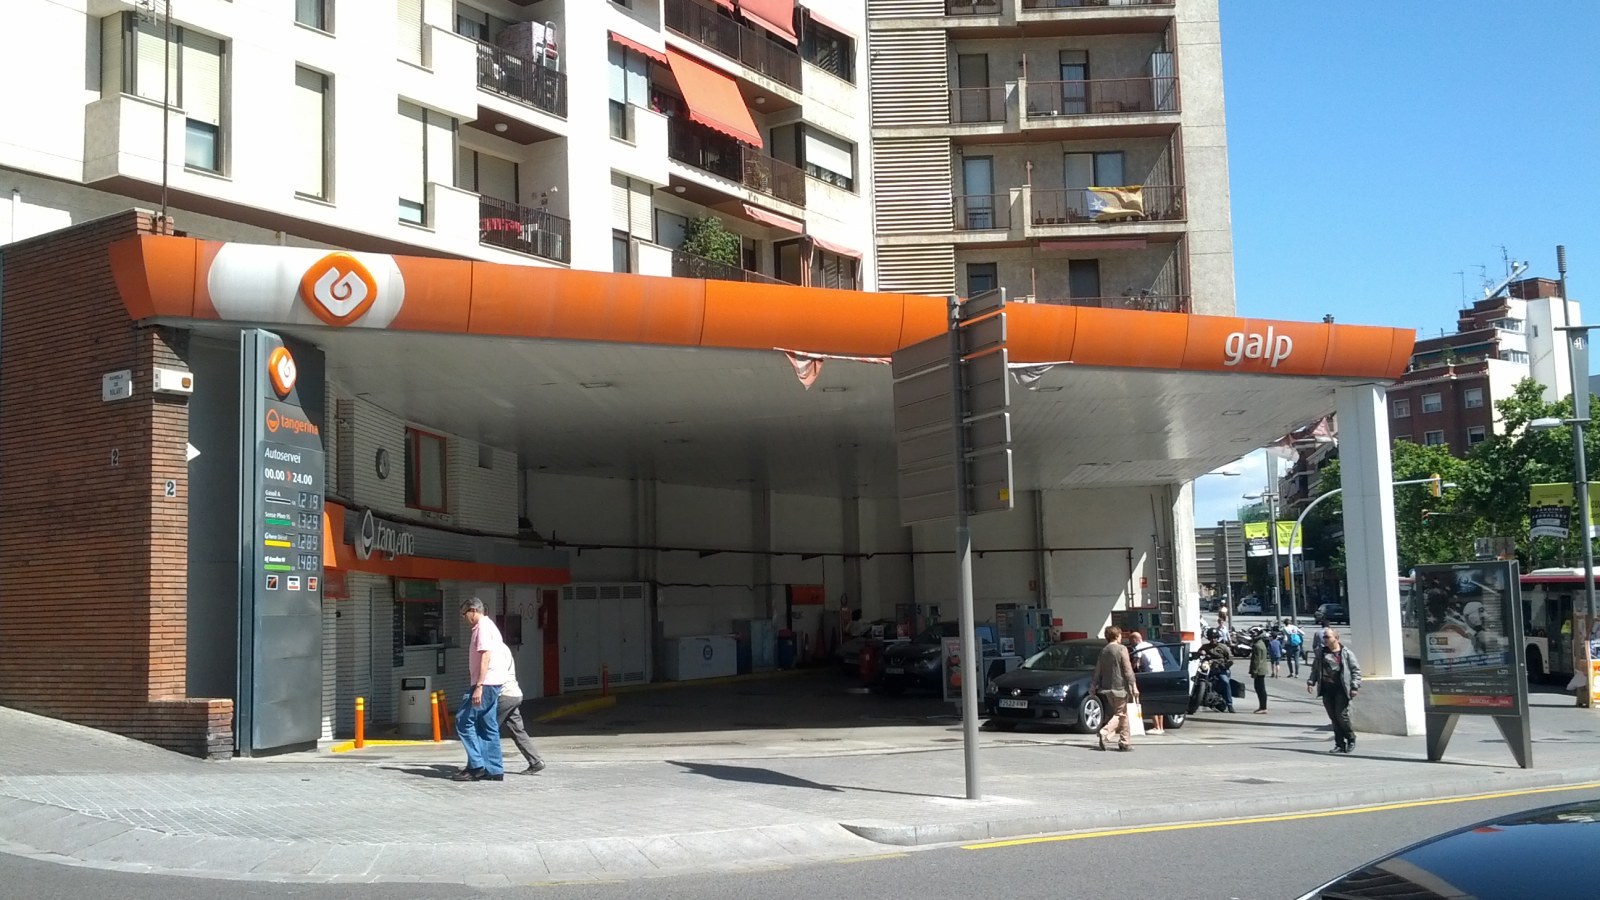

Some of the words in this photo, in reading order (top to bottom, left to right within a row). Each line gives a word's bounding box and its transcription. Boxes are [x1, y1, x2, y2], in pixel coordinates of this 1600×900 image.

[1223, 325, 1293, 368] galp
[281, 414, 319, 436] tangerina
[112, 450, 118, 464] 2
[264, 447, 301, 464] Autoservei
[264, 467, 285, 481] 00.00
[292, 472, 313, 486] 24.00
[166, 480, 175, 496] 2
[1138, 612, 1144, 625] 3
